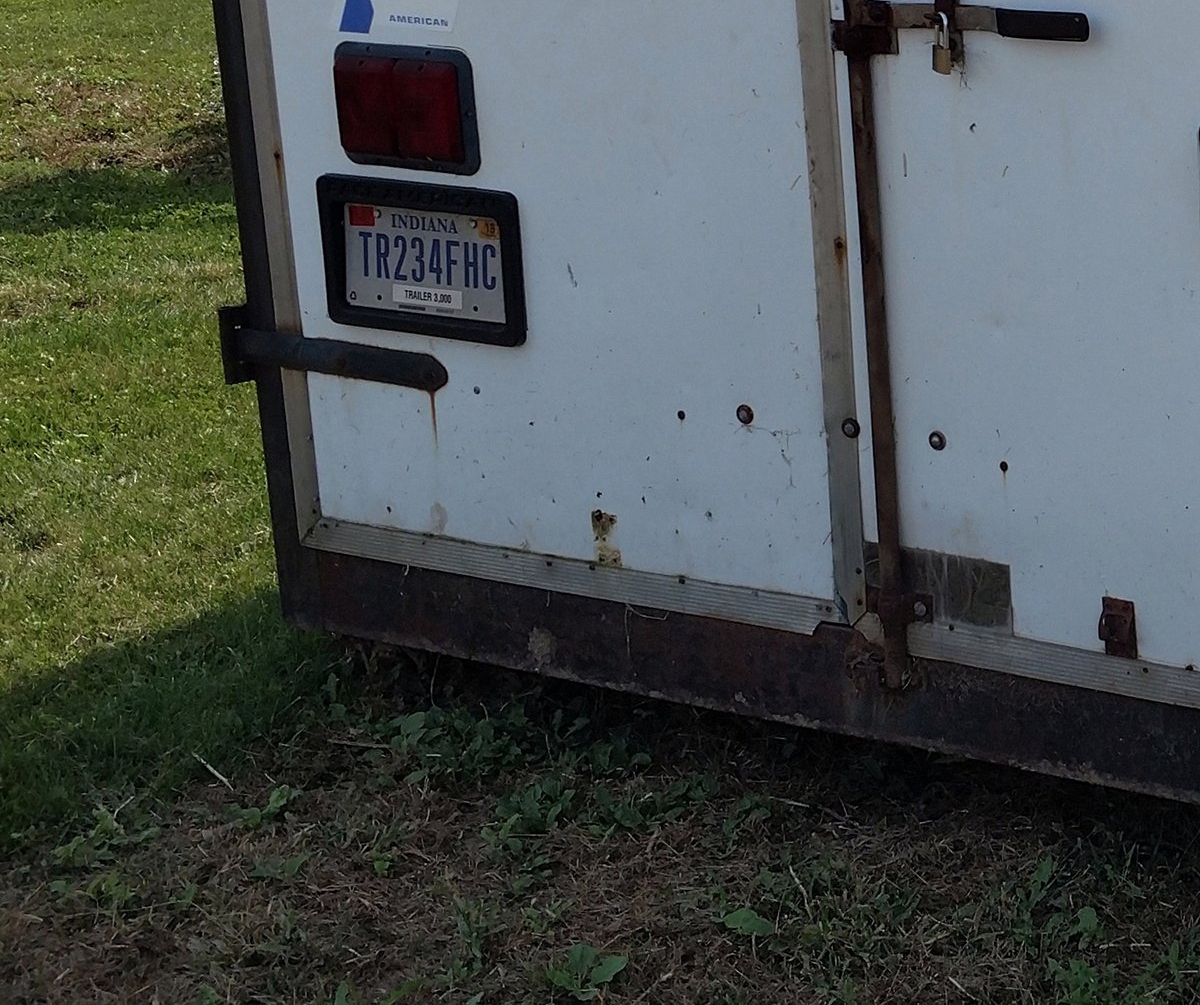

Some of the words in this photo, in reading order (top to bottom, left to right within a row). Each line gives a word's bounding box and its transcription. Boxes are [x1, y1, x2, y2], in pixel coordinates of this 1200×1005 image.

[389, 14, 449, 27] AMERICAN
[391, 213, 459, 235] INDIANA
[358, 231, 497, 291] TR234FHC
[404, 289, 433, 302] TRAILER
[433, 292, 453, 304] 3,000
